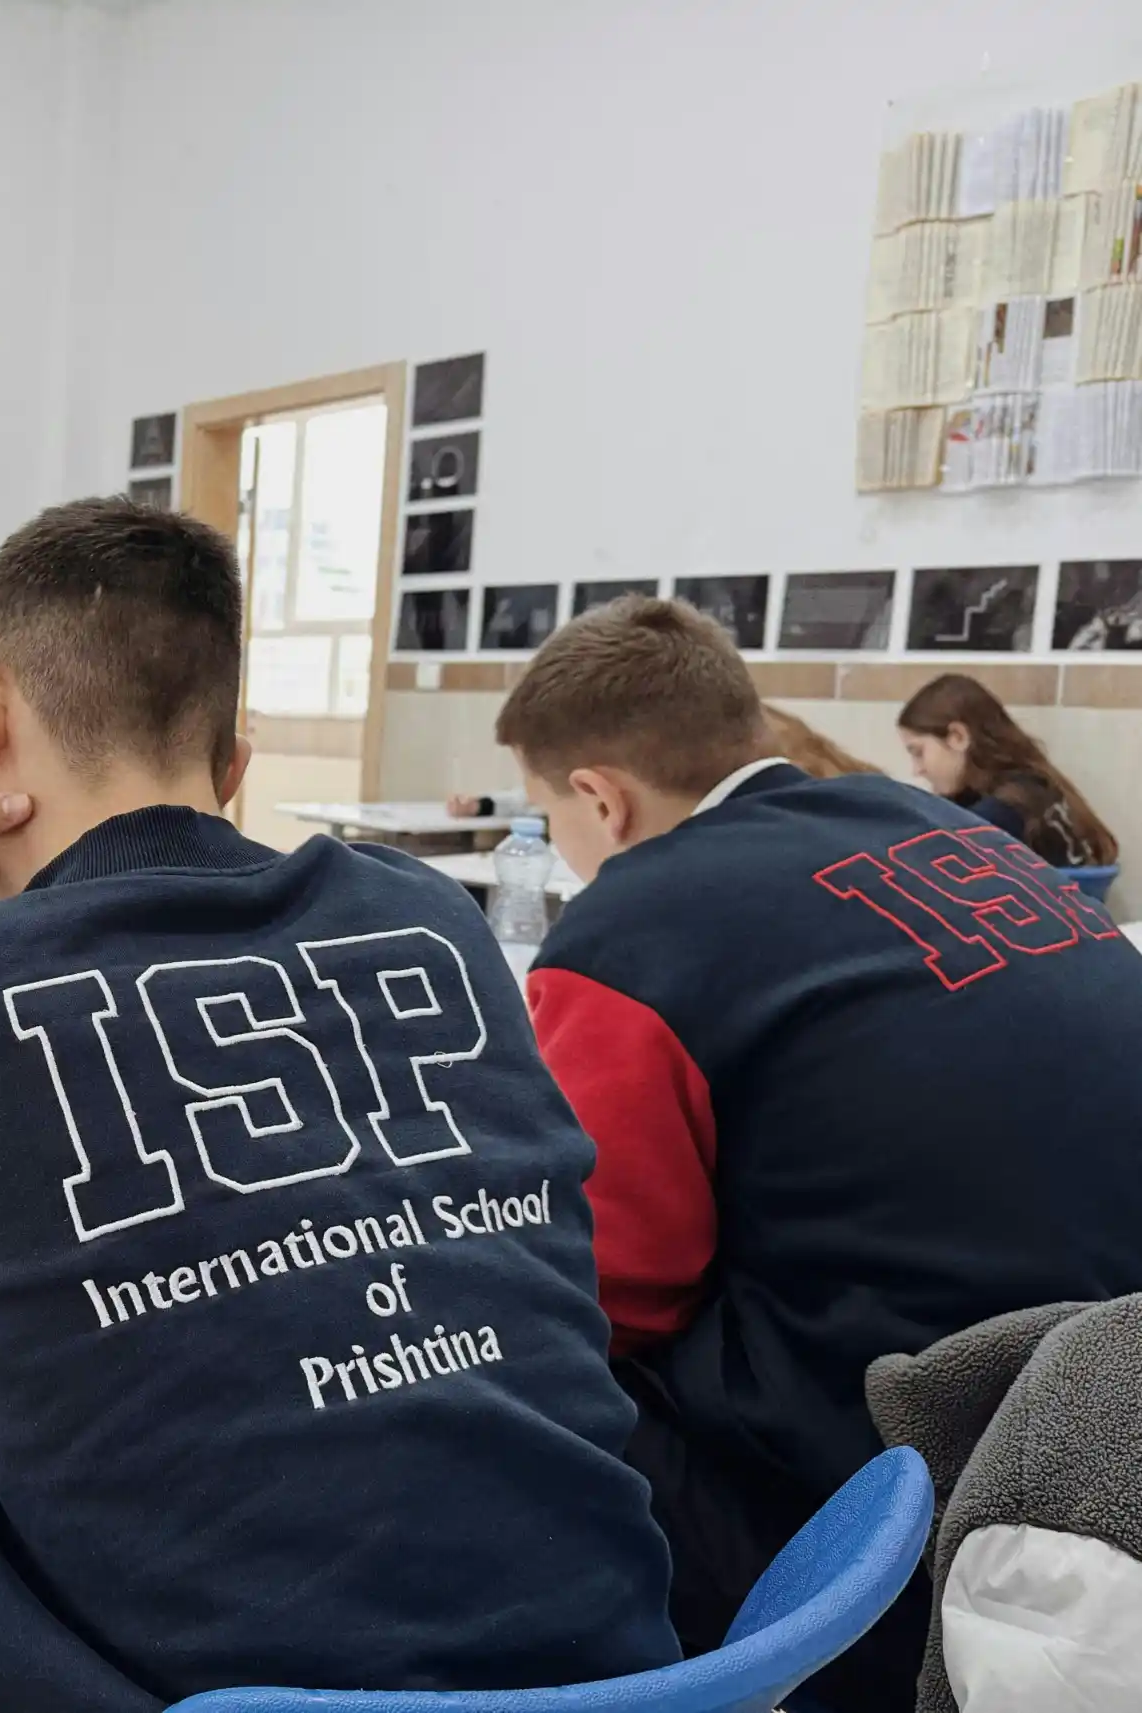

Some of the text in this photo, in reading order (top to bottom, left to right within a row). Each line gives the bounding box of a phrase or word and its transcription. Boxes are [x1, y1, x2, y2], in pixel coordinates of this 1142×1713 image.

[814, 826, 1119, 991] ISP
[3, 926, 488, 1243] ISP
[82, 1179, 552, 1328] International School
[366, 1262, 412, 1318] of
[300, 1324, 504, 1410] Prishtina
